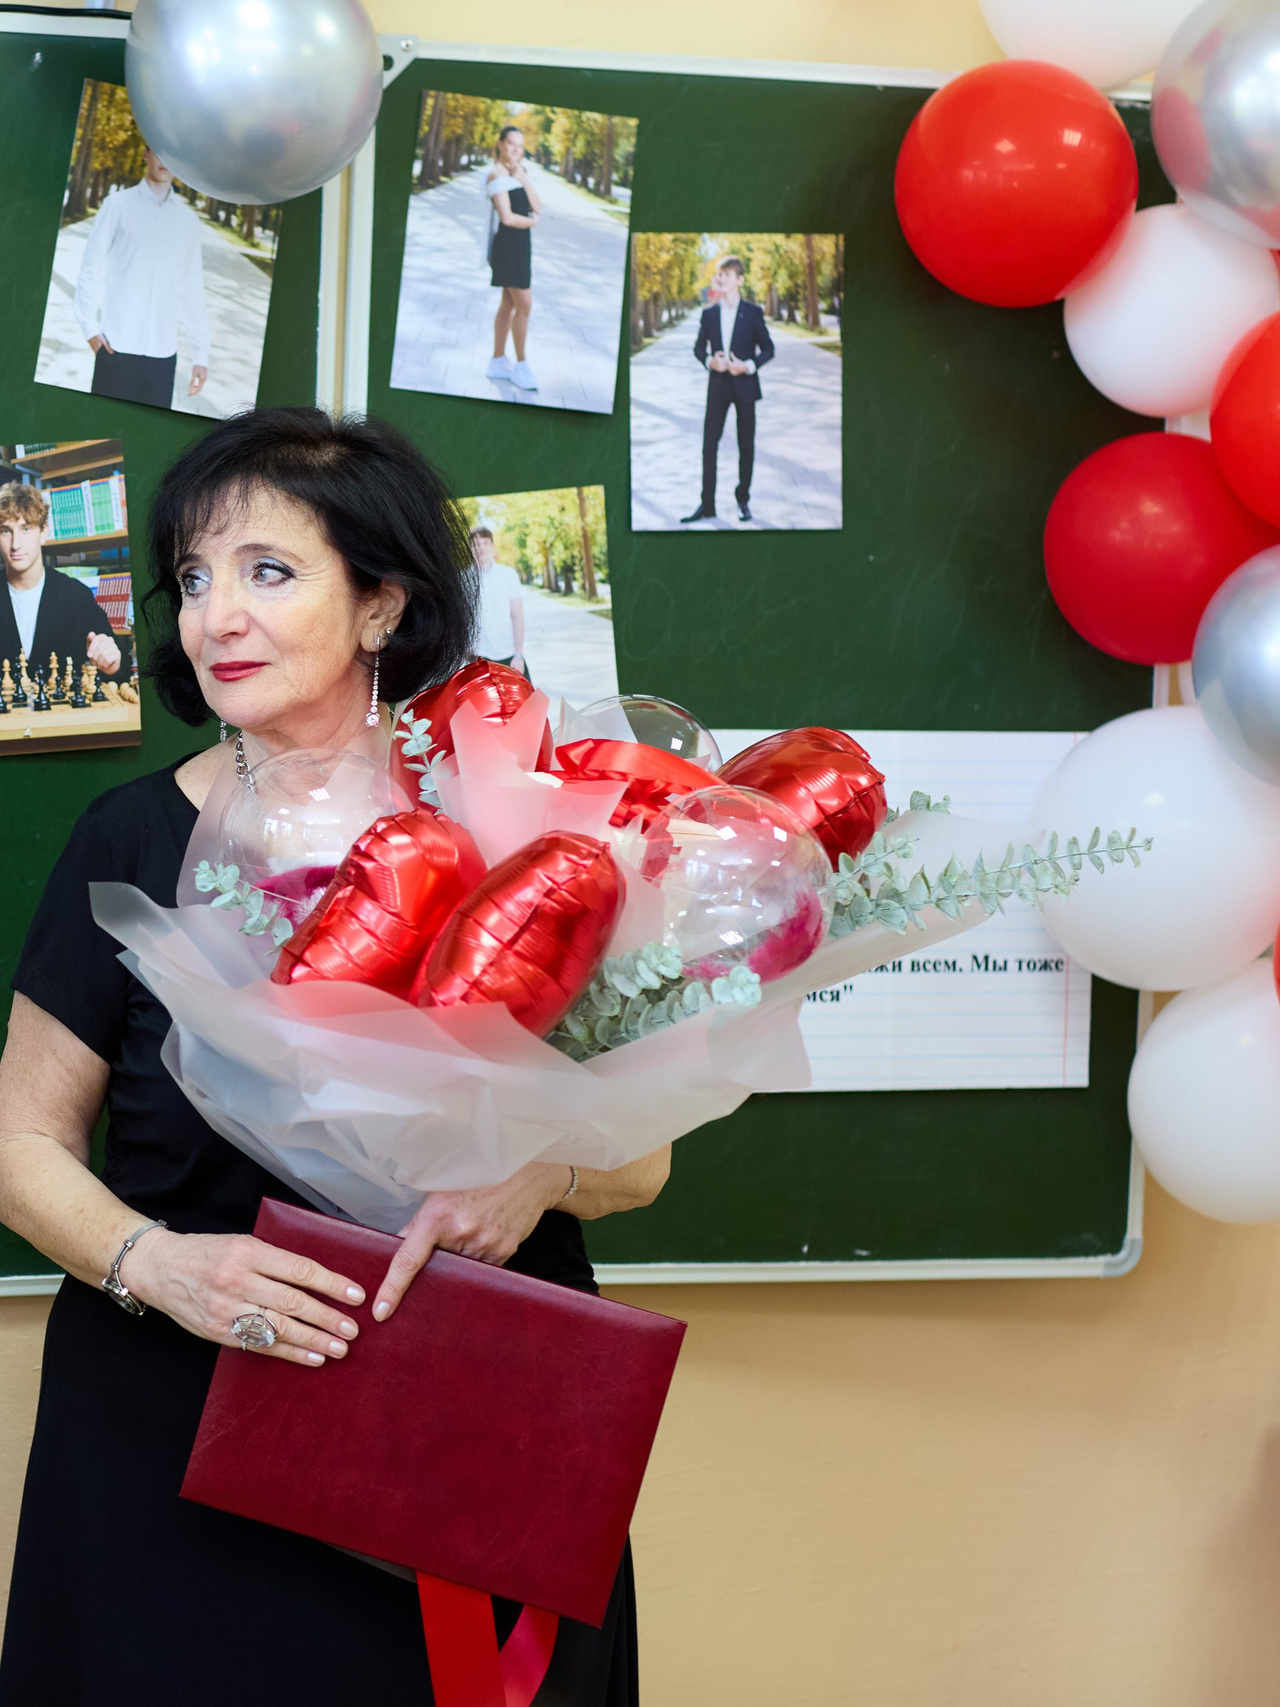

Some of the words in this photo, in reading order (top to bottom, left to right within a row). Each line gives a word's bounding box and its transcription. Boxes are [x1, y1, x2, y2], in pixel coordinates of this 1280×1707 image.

[868, 960, 902, 973] жи
[910, 959, 963, 973] всем.
[971, 953, 1008, 972] Мы
[1015, 957, 1065, 972] тоже
